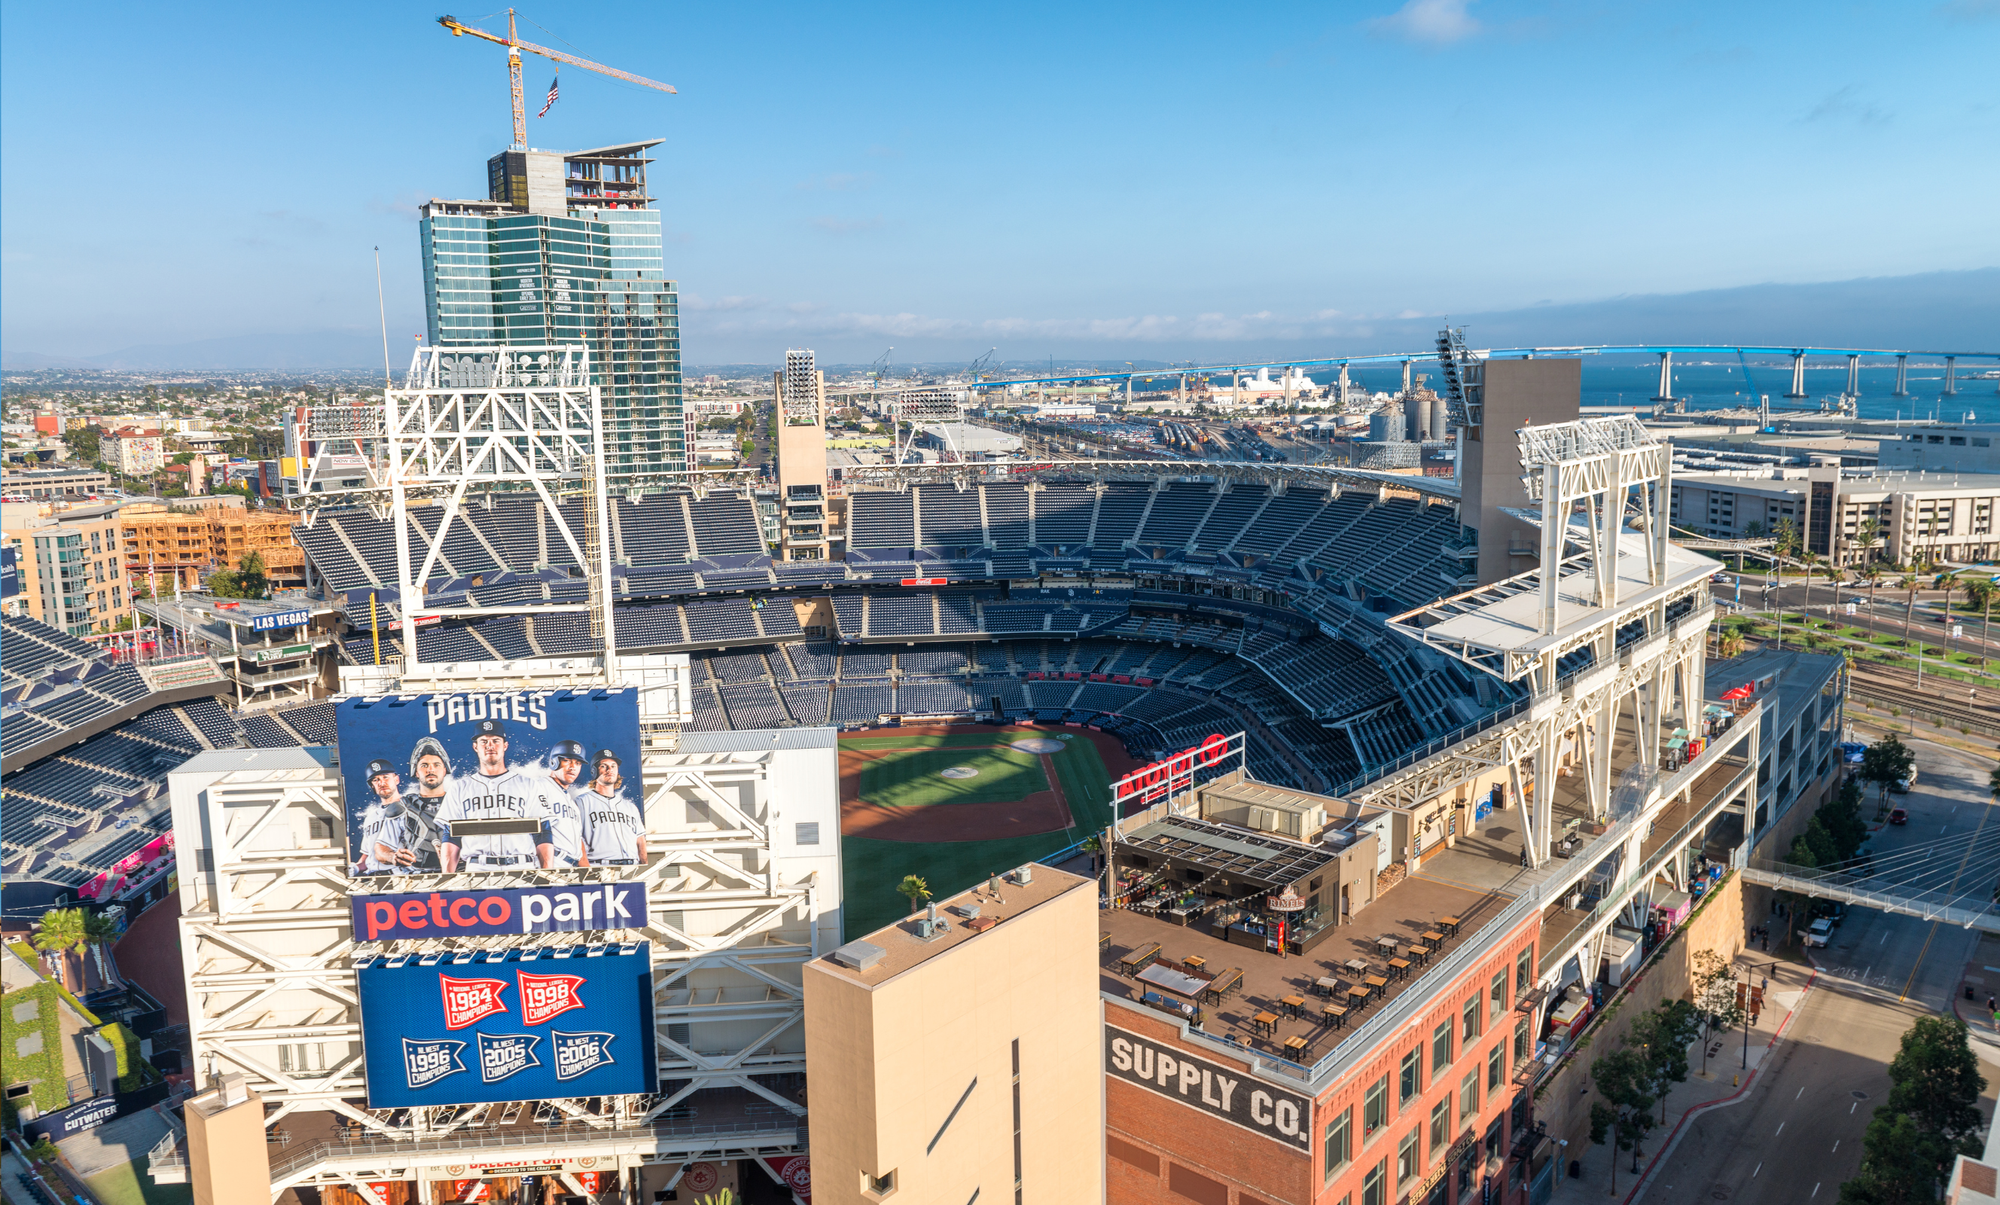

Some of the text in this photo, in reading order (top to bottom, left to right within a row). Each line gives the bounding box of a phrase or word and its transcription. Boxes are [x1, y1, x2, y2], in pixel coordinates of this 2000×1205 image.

[255, 611, 308, 630] LAS VEGAS
[426, 692, 547, 734] PADRES
[462, 793, 526, 821] PADRES
[589, 811, 638, 836] PADRES
[365, 885, 632, 940] petco park
[449, 988, 493, 1012] 1984
[526, 984, 569, 1008] 1998
[452, 1002, 493, 1023] CHAMPIONS
[529, 998, 569, 1019] CHAMPIONS
[417, 1044, 440, 1054] NL WEST
[492, 1039, 515, 1049] NL WEST
[558, 1042, 600, 1065] 2006
[567, 1037, 589, 1047] NL WEST
[409, 1050, 450, 1073] 1996
[484, 1044, 526, 1067] 2005
[560, 1055, 600, 1076] CHAMPIONS
[412, 1063, 451, 1084] CHAMPIONS
[486, 1057, 526, 1078] CHAMPIONS
[1111, 1037, 1308, 1142] SUPPLY CO.
[64, 1104, 117, 1131] CUTWATER
[81, 1119, 104, 1131] SPIRITS
